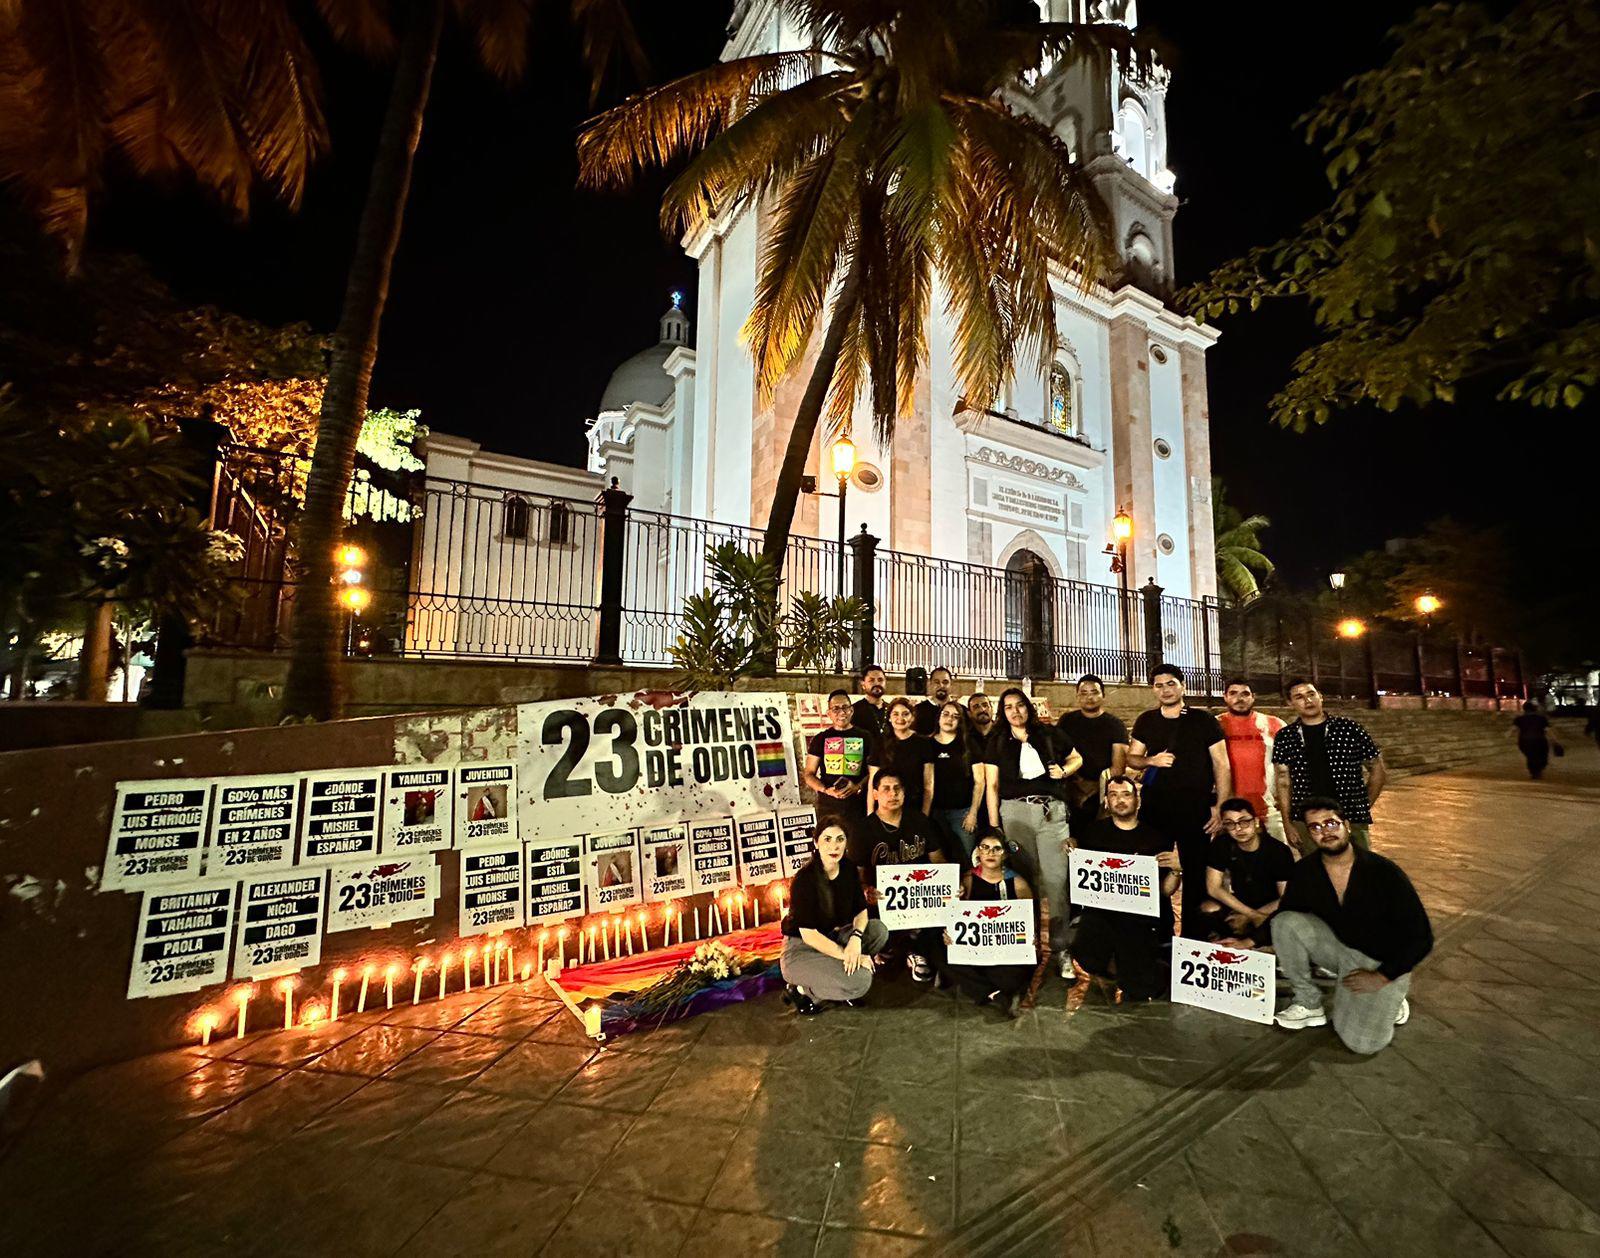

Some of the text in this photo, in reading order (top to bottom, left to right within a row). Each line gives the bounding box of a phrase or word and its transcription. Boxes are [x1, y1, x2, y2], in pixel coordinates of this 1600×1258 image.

[541, 708, 640, 800] 23
[646, 744, 755, 788] DE ODIO
[399, 773, 442, 785] YAMILETH
[466, 769, 509, 780] JUVENTINO
[228, 787, 287, 801] 60% MÁS
[325, 782, 364, 794] ¿DÓNDE
[144, 793, 184, 807] PEDRO
[331, 799, 355, 811] ESTÁ
[121, 811, 201, 829] LUIS ENRIQUE
[229, 807, 284, 820] CRÍMENES
[322, 820, 360, 833] MISHEL
[468, 825, 482, 837] 23
[696, 827, 726, 838] 60% MÁS
[225, 827, 282, 842] EN 2 AÑOS
[397, 832, 413, 846] 23
[135, 835, 180, 850] MONSE
[316, 840, 362, 854] ESPAÑA?
[225, 850, 246, 865] 23
[479, 855, 505, 867] PEDRO
[540, 849, 570, 861] ¿DÓNDE
[751, 850, 769, 859] PAOLA
[124, 859, 149, 875] 23
[698, 857, 728, 869] EN 2 AÑOS
[792, 859, 801, 869] 23
[547, 865, 565, 876] ESTÁ
[750, 866, 759, 877] 23
[373, 876, 425, 893] CRÍMENES
[466, 871, 519, 886] LUIS ENRIQUE
[702, 873, 711, 885] 23
[1078, 868, 1102, 892] 23
[1104, 871, 1150, 886] CRÍMENES
[253, 880, 315, 898] ALEXANDER
[542, 883, 570, 895] MISHEL
[653, 881, 665, 894] 23
[910, 884, 952, 896] CRÍMENES
[1104, 883, 1139, 896] DE ODIO
[160, 892, 219, 910] BRITANNY
[338, 883, 371, 912] 23
[372, 891, 413, 906] DE ODIO
[477, 892, 507, 904] MONSE
[600, 890, 612, 903] 23
[885, 886, 908, 911] 23
[910, 897, 942, 909] DE ODIO
[267, 903, 298, 917] NICOL
[539, 901, 573, 914] ESPAÑA?
[161, 914, 212, 931] YAHAIRA
[473, 913, 488, 926] 23
[982, 920, 1025, 933] CRÍMENES
[265, 924, 295, 939] DAGO
[955, 922, 980, 946] 23
[163, 938, 203, 955] PAOLA
[982, 934, 1015, 946] DE ODIO
[253, 948, 273, 965] 23
[150, 965, 174, 984] 23
[1181, 961, 1210, 988] 23
[1212, 966, 1265, 988] CRÍMENES
[1211, 979, 1223, 992] DE
